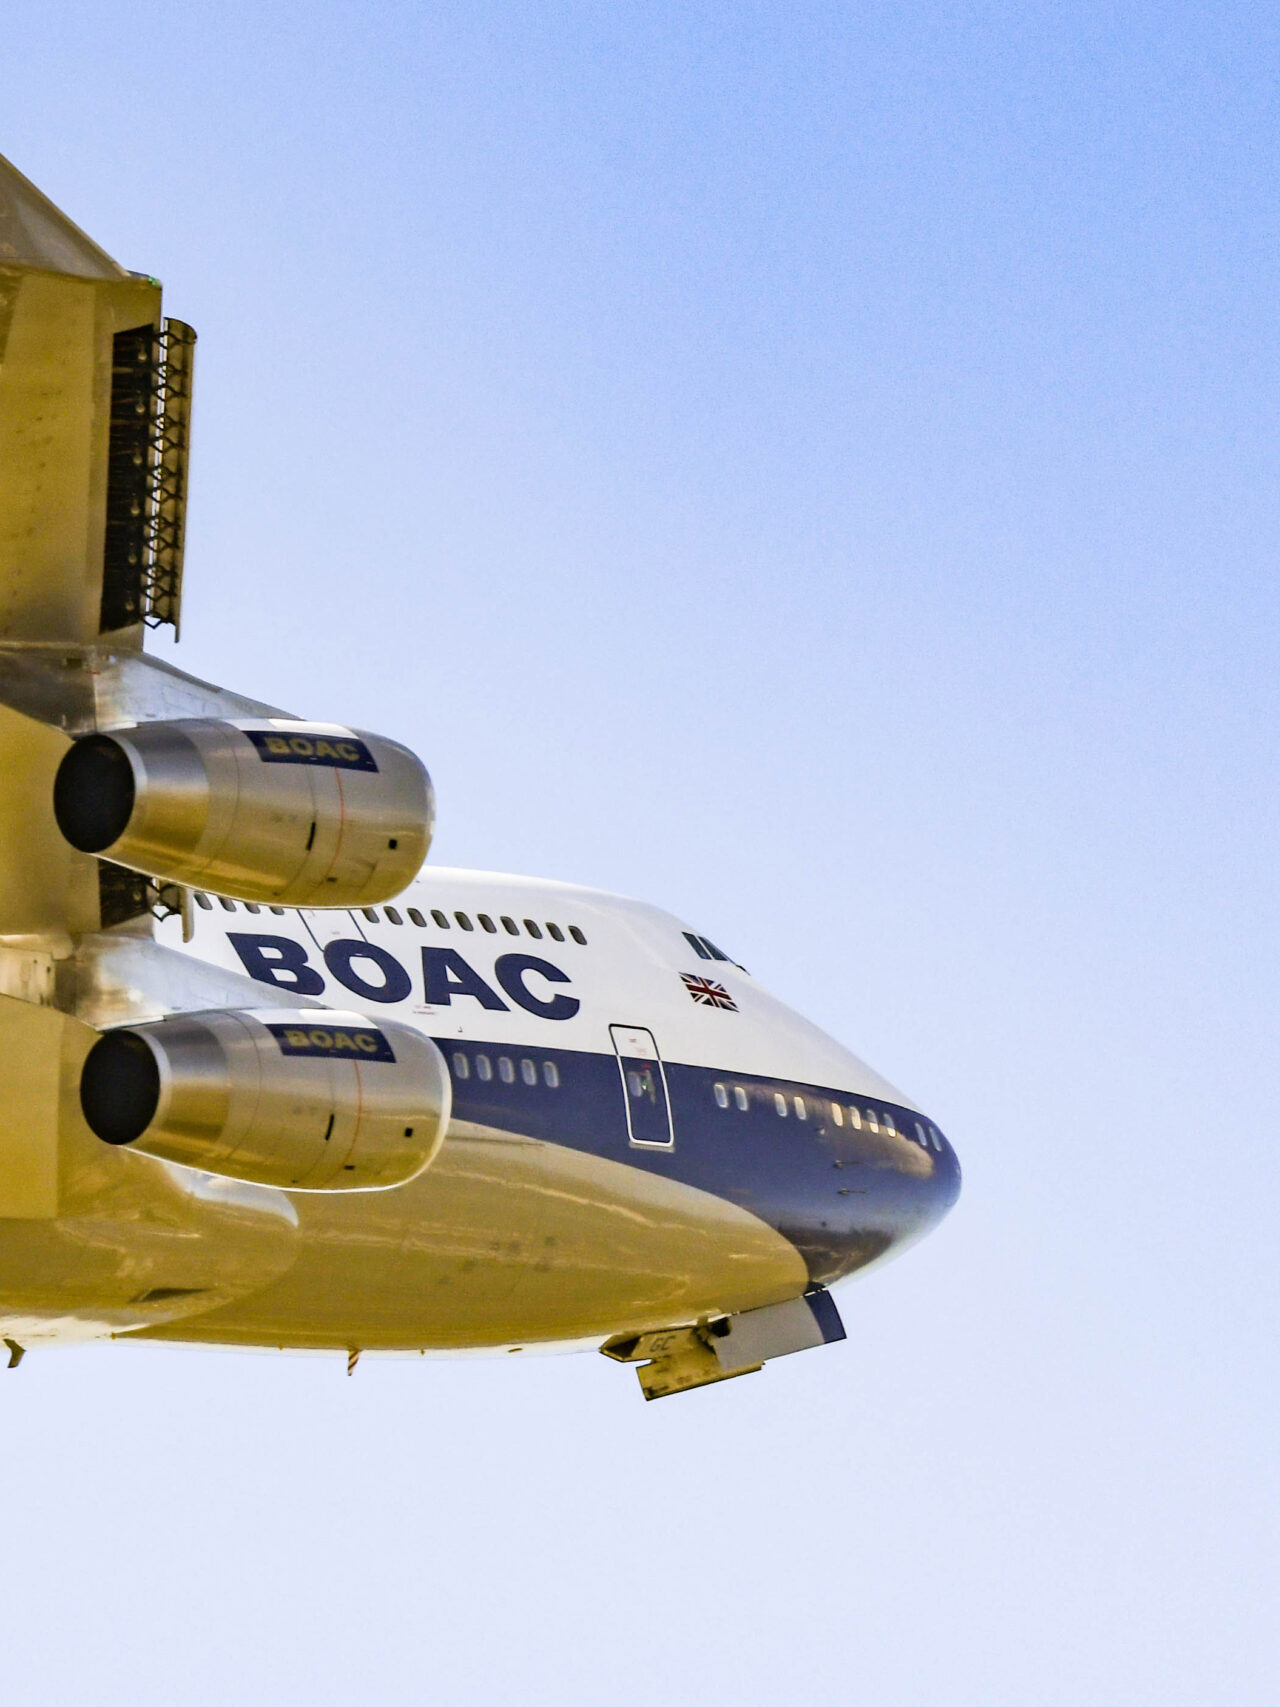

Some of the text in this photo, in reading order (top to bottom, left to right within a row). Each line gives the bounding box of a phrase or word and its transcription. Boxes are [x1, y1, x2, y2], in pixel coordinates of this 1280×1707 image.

[264, 737, 360, 761] BOAC
[226, 932, 580, 1020] BOAC
[283, 1030, 377, 1053] BOAC
